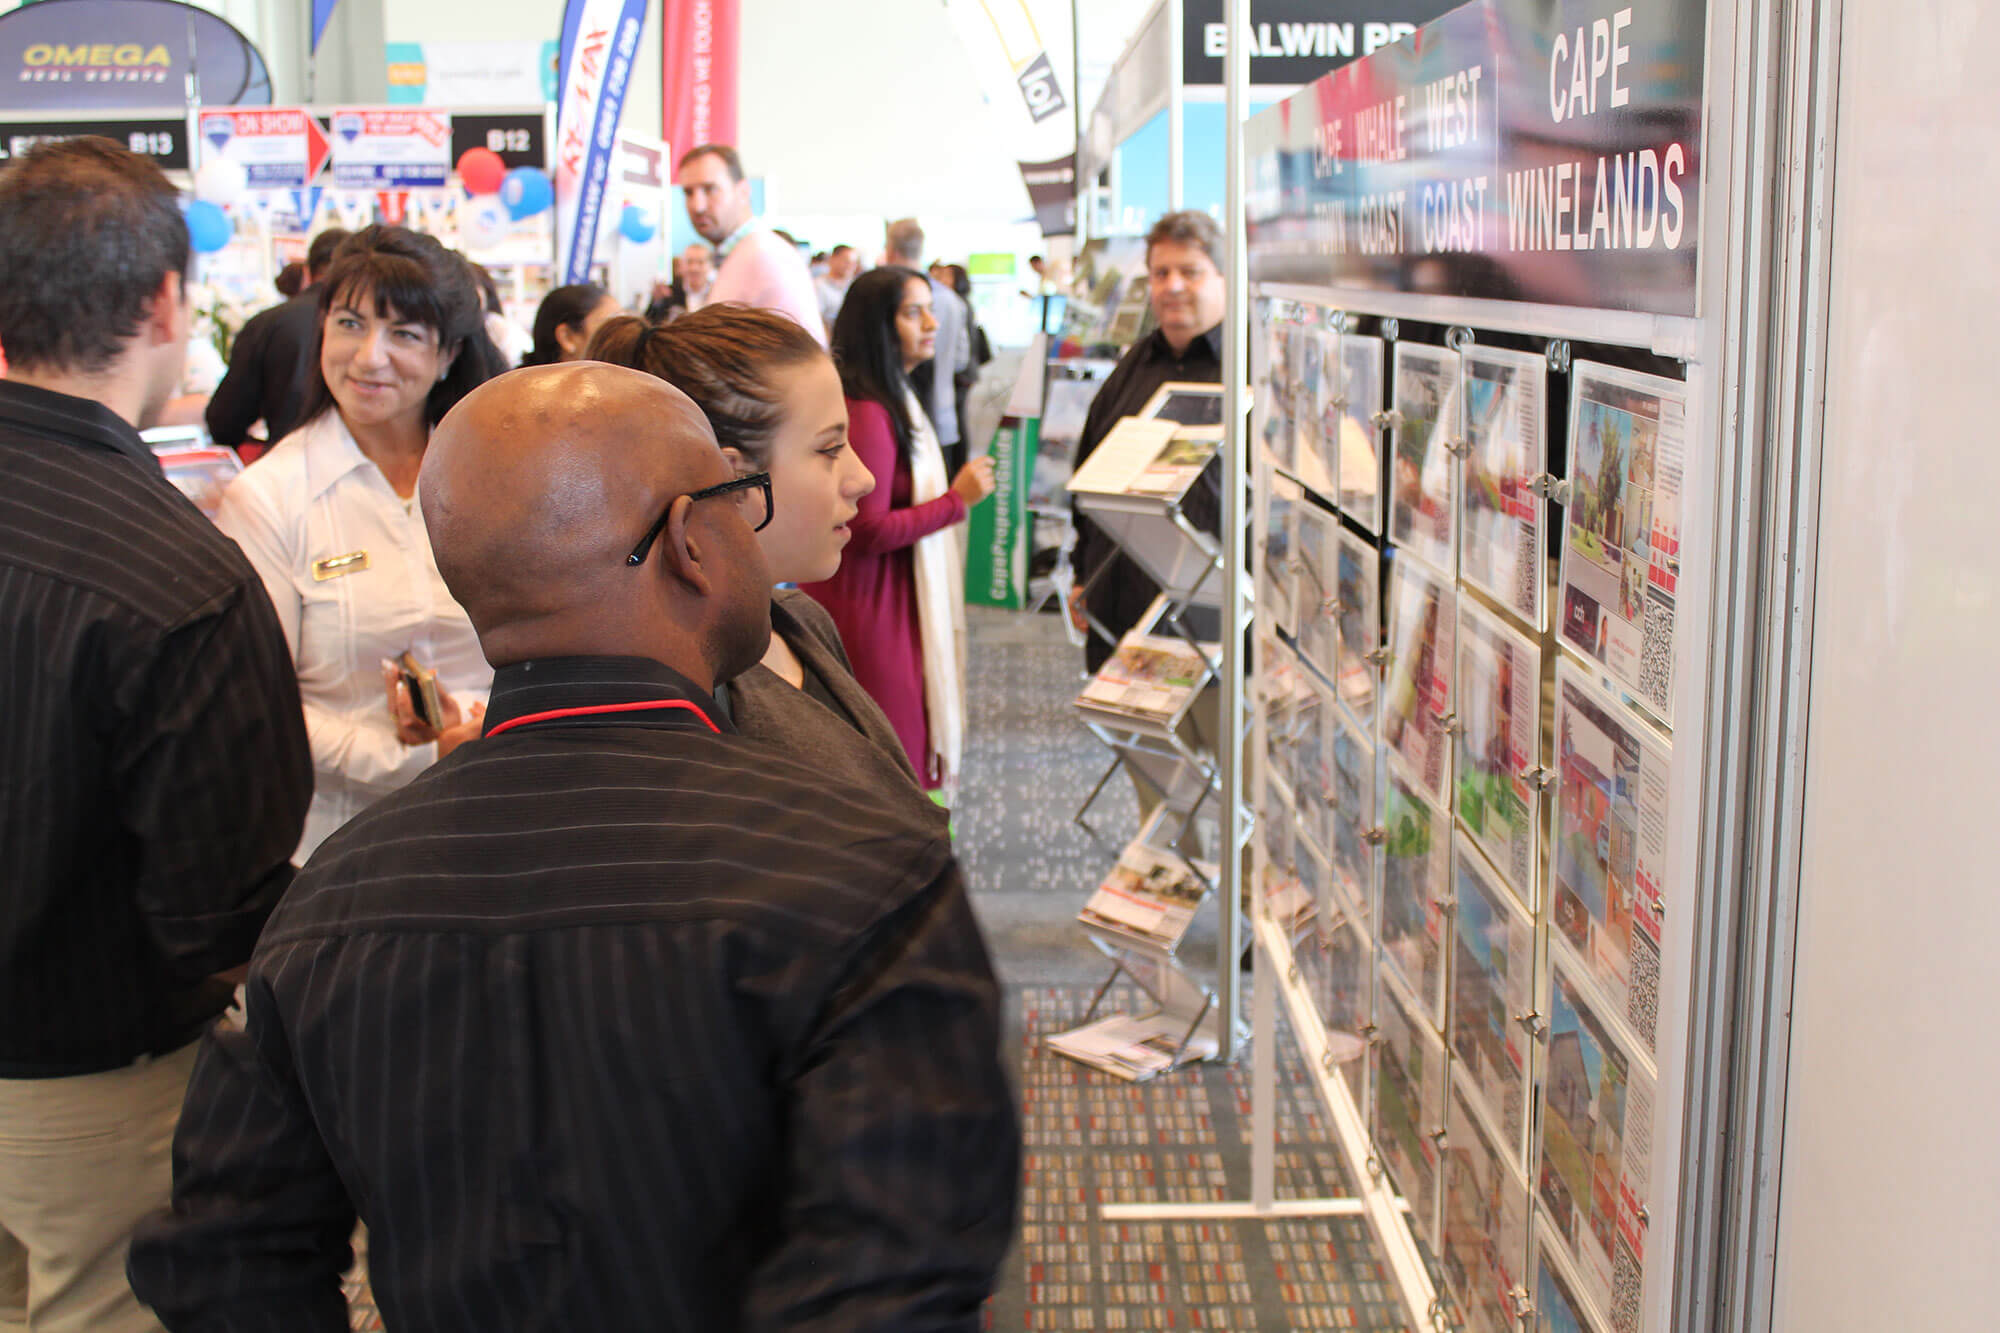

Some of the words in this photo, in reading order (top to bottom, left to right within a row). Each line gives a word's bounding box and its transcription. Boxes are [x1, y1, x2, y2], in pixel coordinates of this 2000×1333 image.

[23, 44, 172, 67] OMEGA
[1549, 7, 1633, 124] CAPE
[127, 131, 175, 155] B13
[486, 128, 531, 152] B12
[1354, 95, 1407, 169] WHALE
[1425, 65, 1482, 152] WEST
[1313, 118, 1344, 179] CAPE
[1359, 190, 1407, 256] COAST
[1423, 175, 1489, 254] COAST
[1506, 142, 1686, 251] WINELANDS
